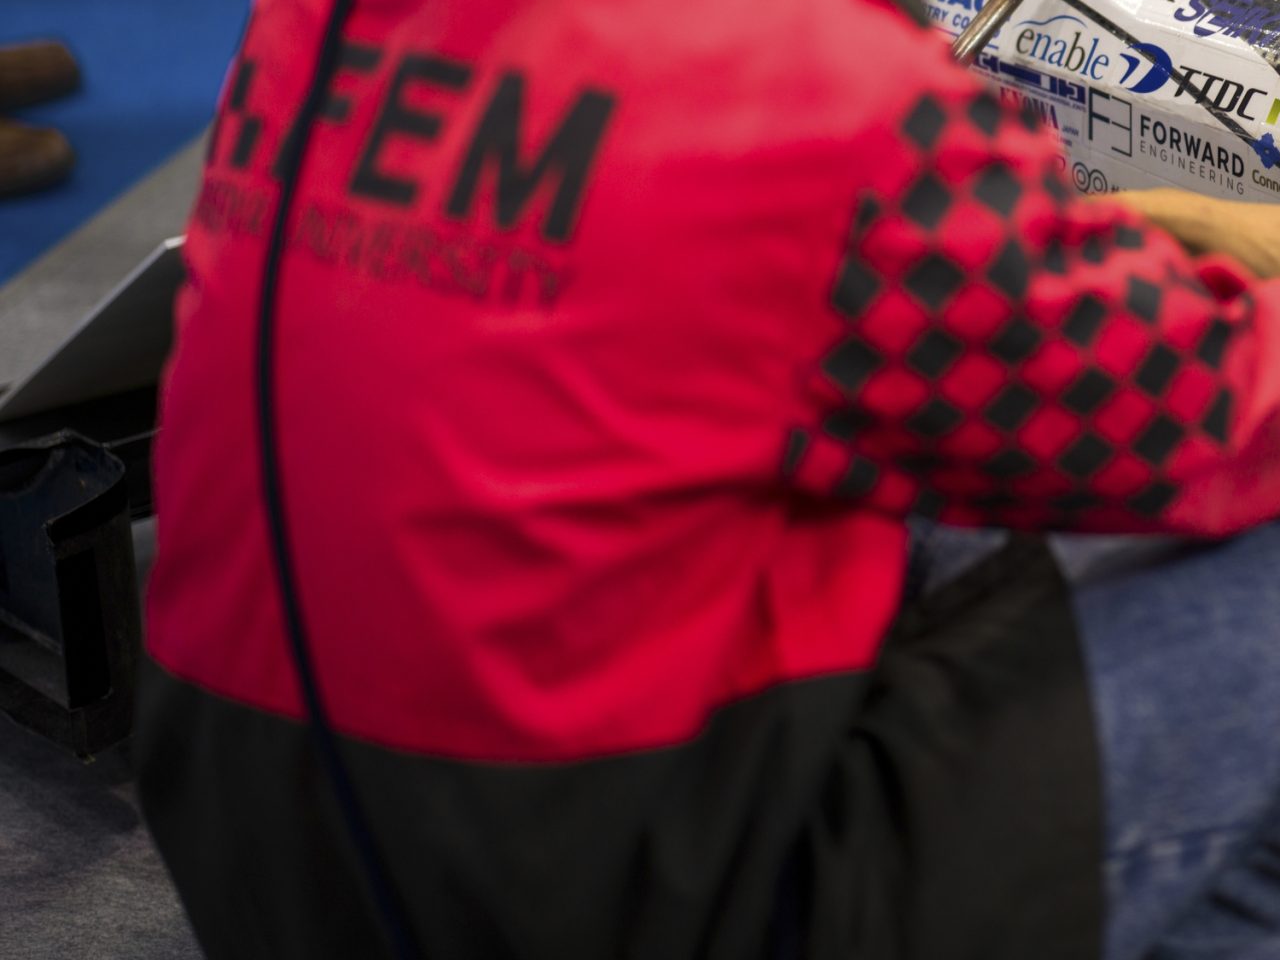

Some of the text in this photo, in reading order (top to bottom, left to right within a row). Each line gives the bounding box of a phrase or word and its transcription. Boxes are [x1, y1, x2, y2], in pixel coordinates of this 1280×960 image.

[1016, 26, 1109, 81] enable
[1175, 65, 1268, 121] TTDC
[1140, 114, 1245, 178] FORWARD
[1140, 142, 1245, 195] ENGINEERING
